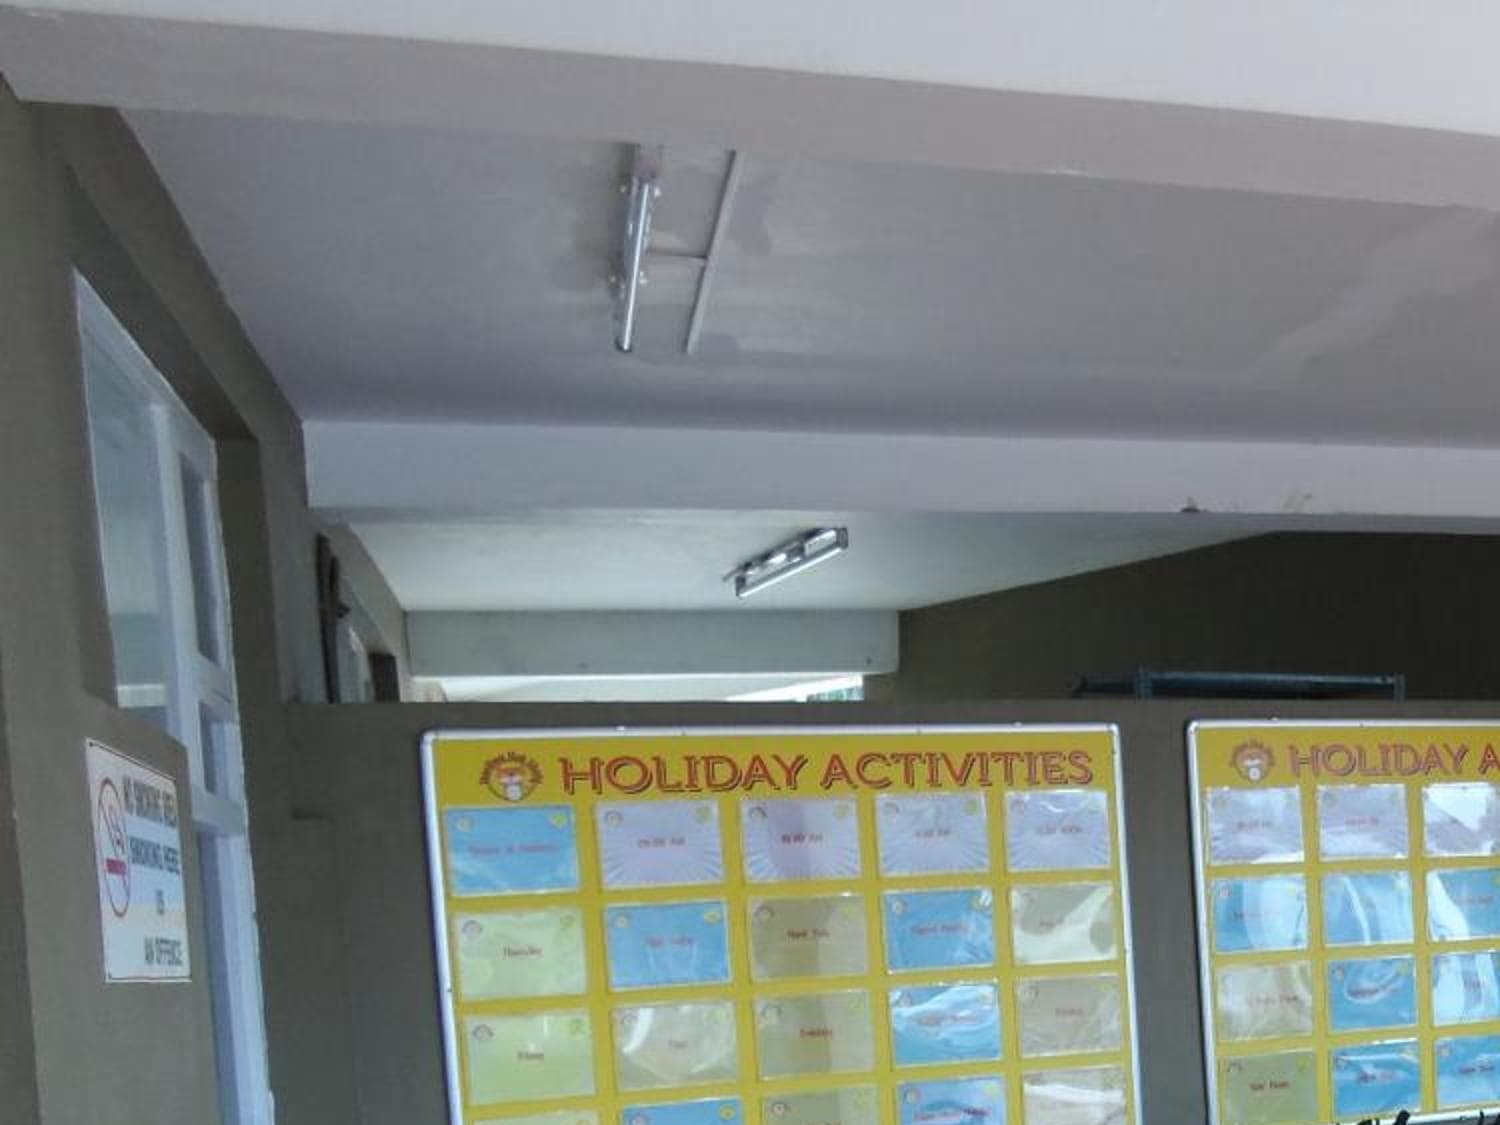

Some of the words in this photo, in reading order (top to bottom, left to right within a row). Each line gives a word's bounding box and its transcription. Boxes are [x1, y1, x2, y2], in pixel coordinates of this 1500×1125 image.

[558, 753, 808, 795] HOLIDAY
[820, 750, 1093, 789] ACTIVITIES
[1288, 742, 1469, 777] HOLIDAY
